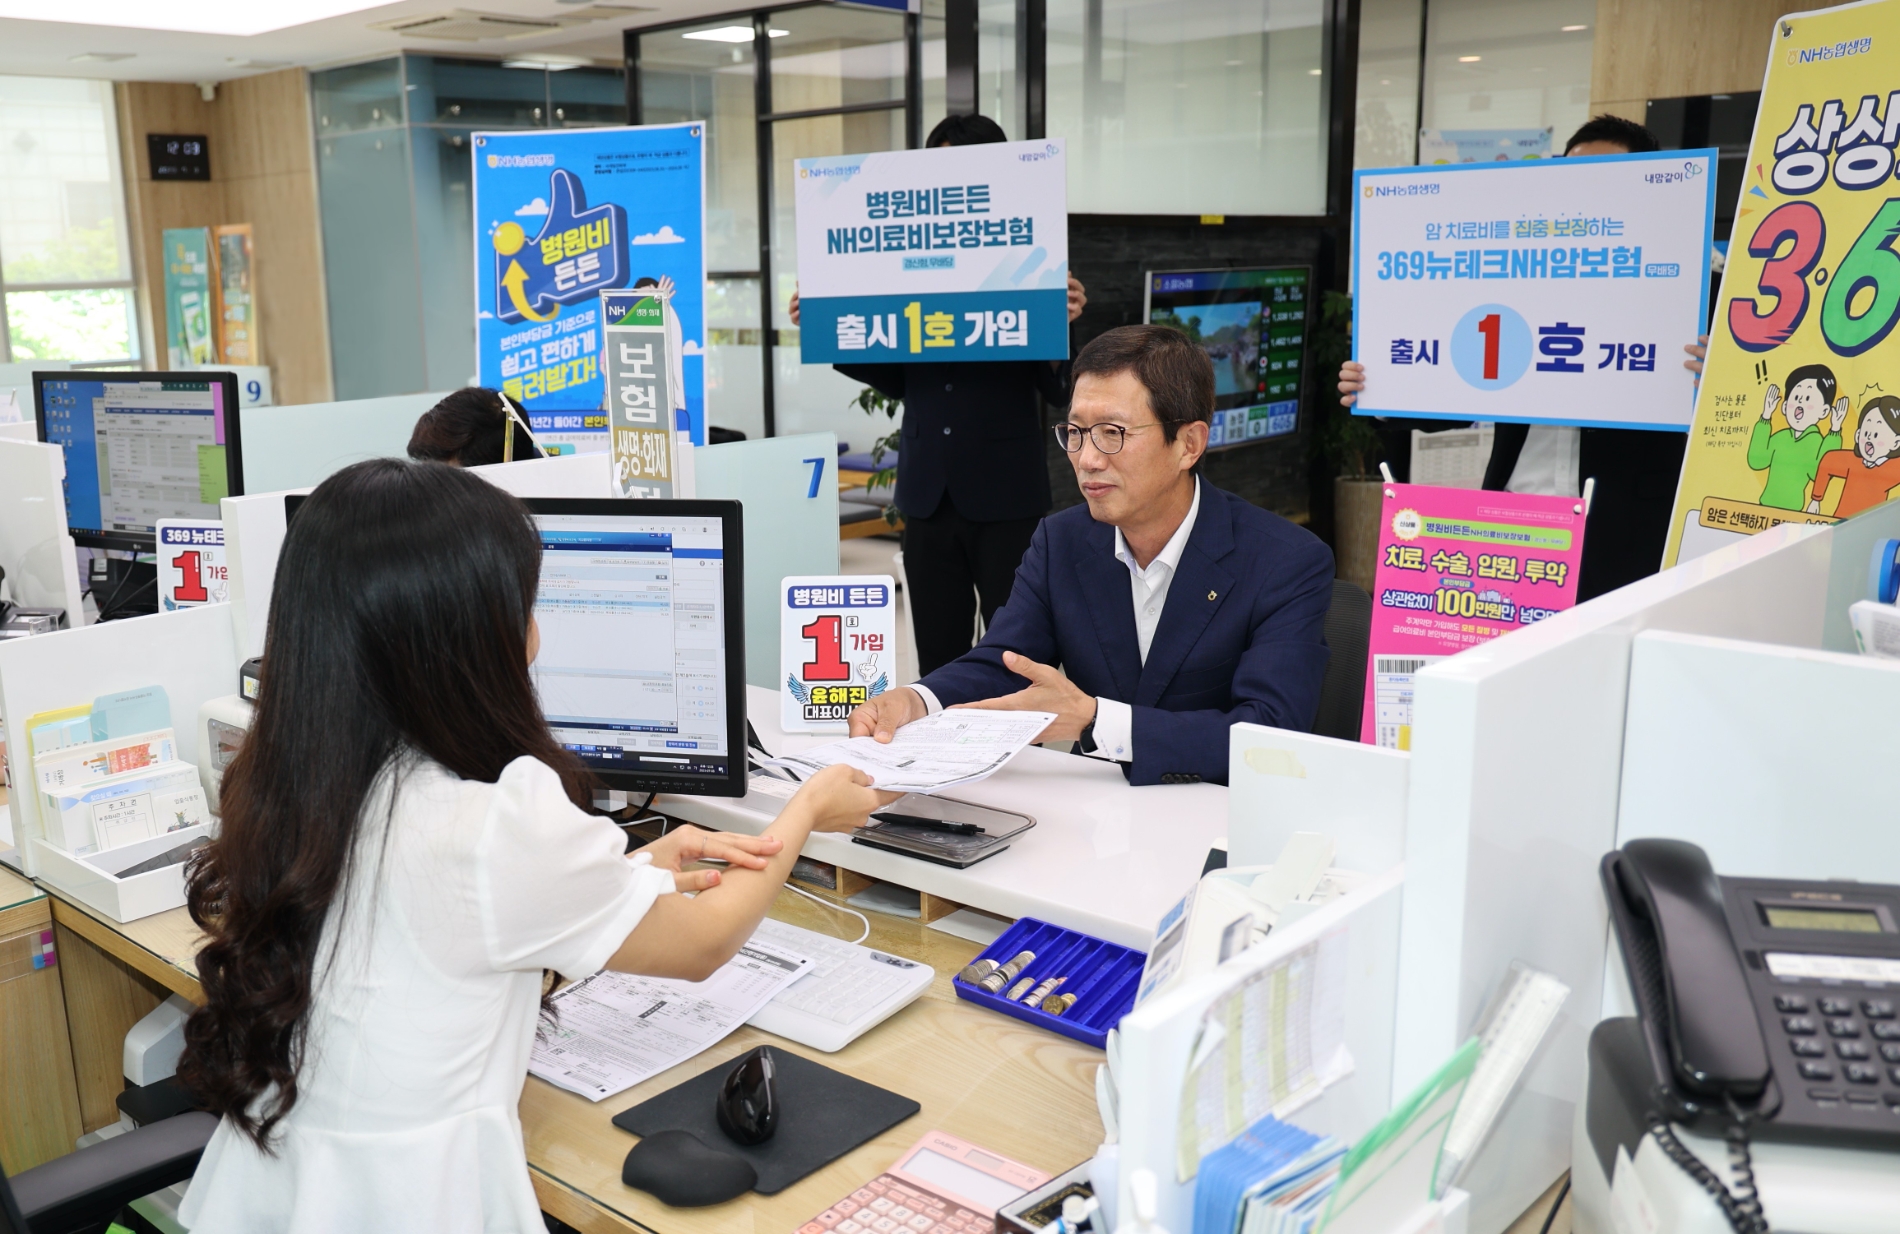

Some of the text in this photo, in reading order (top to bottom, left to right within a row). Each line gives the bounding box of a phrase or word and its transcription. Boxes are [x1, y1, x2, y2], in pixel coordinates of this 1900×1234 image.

[1799, 37, 1872, 63] NH농협생명
[1376, 183, 1440, 197] NH농협생명
[1645, 172, 1682, 183] 내맘같이
[866, 184, 990, 219] 병원비든든
[540, 217, 611, 266] 병원비
[827, 217, 1034, 255] NH의료비보장보험
[1426, 216, 1624, 241] 암 치료비를 집중 보장하는
[554, 251, 600, 292] 든든
[1377, 246, 1679, 280] 369뉴테크NH암보험 무배당
[608, 305, 626, 316] NH
[500, 309, 596, 351] 본인부담금 기준으로
[837, 313, 897, 350] 출시
[964, 310, 1028, 347] 가입
[501, 329, 596, 377] 쉽고 편하게
[1390, 314, 1656, 380] 출시 1 호 가입
[246, 380, 261, 403] 9
[1715, 410, 1741, 421] 진단부터
[803, 457, 825, 499] 7
[1707, 507, 1728, 524] 암은
[1730, 511, 1769, 531] 선택하지
[166, 529, 191, 542] 369
[172, 550, 208, 602] 1
[1385, 546, 1568, 587] 치료, 수술, 입원, 투약
[794, 587, 884, 605] 병원비 든든
[1382, 590, 1434, 611] 상관없이
[802, 615, 850, 681] 1
[850, 633, 884, 651] 가입
[811, 687, 866, 704] 윤해진
[933, 1138, 958, 1151] CASIO
